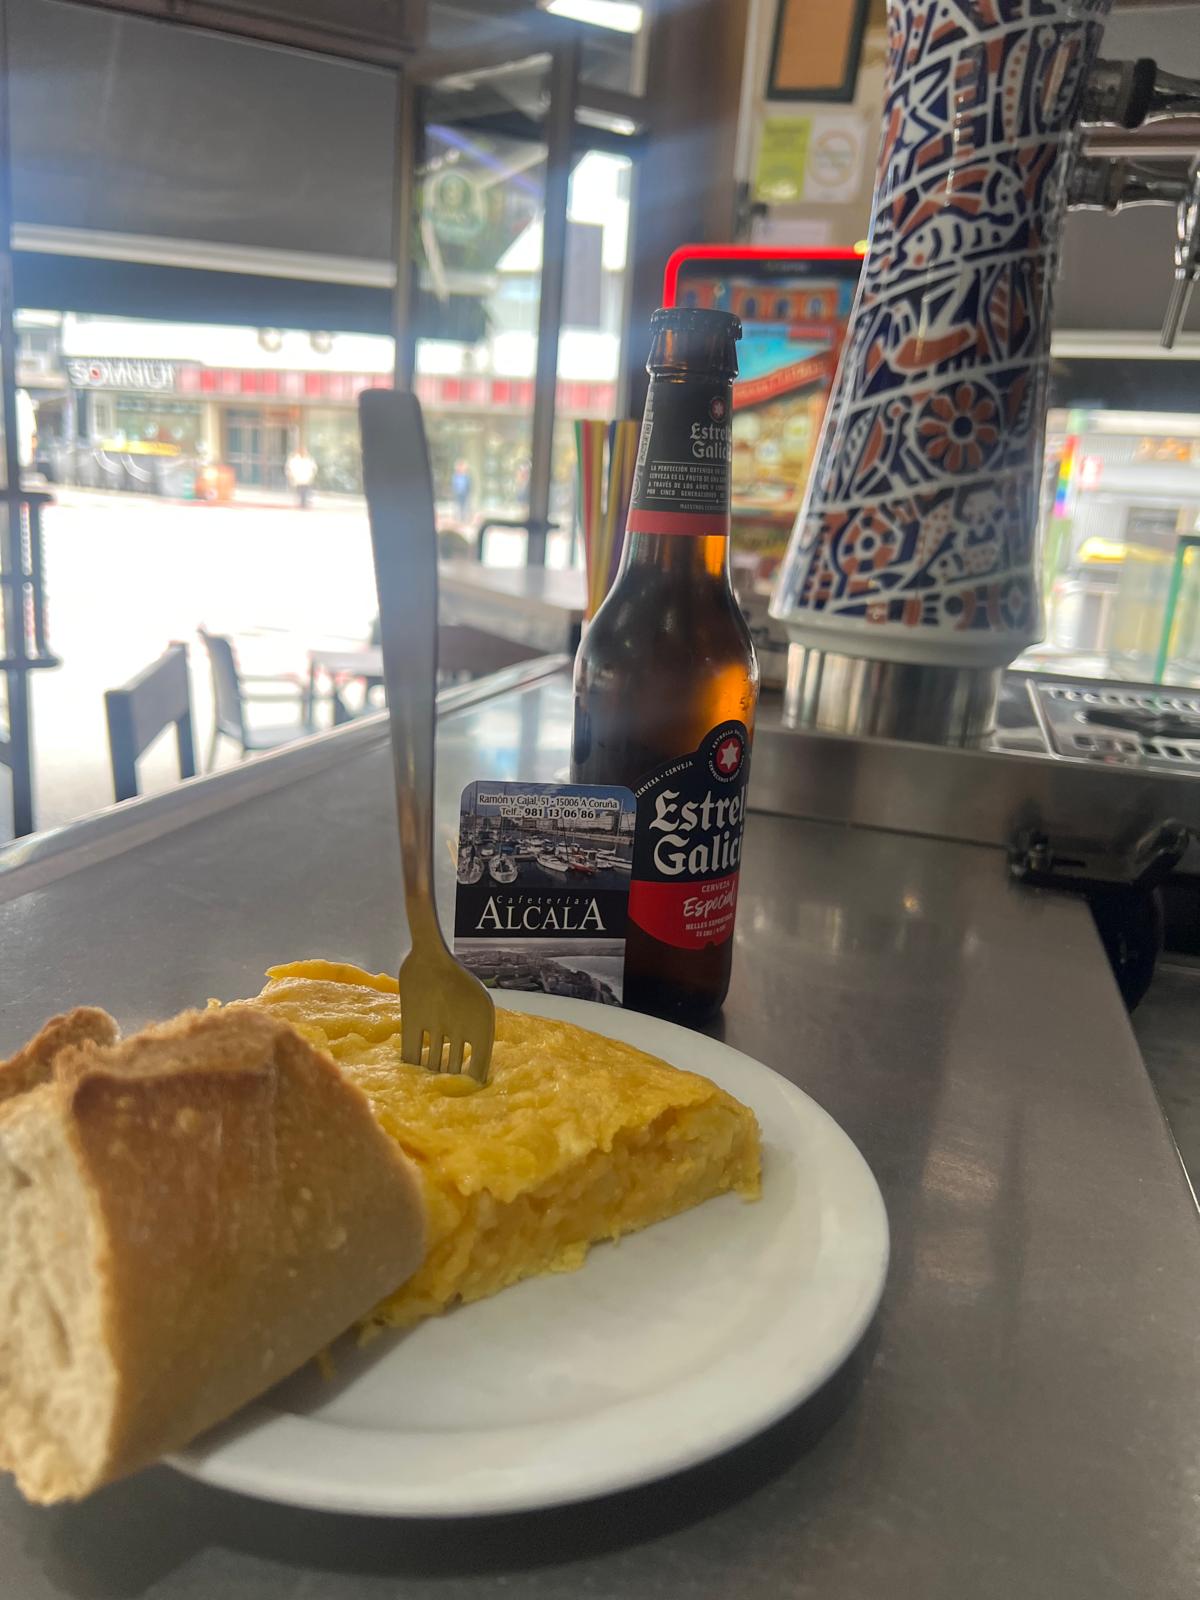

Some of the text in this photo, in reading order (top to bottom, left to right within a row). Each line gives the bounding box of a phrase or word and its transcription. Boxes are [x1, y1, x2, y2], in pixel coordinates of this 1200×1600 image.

[690, 422, 731, 442] Estrel
[658, 465, 688, 473] PERFECCIÓN
[634, 760, 693, 799] CERVEXA CERVEJA
[479, 795, 618, 809] Ramón y Cajal, 51 15006 A Coruña
[524, 808, 543, 817] 981
[549, 809, 559, 818] 13
[564, 809, 577, 818] 06
[581, 810, 594, 819] 86
[702, 880, 730, 893] CERVEZA
[683, 879, 736, 919] Especial
[475, 895, 607, 931] ALCALA
